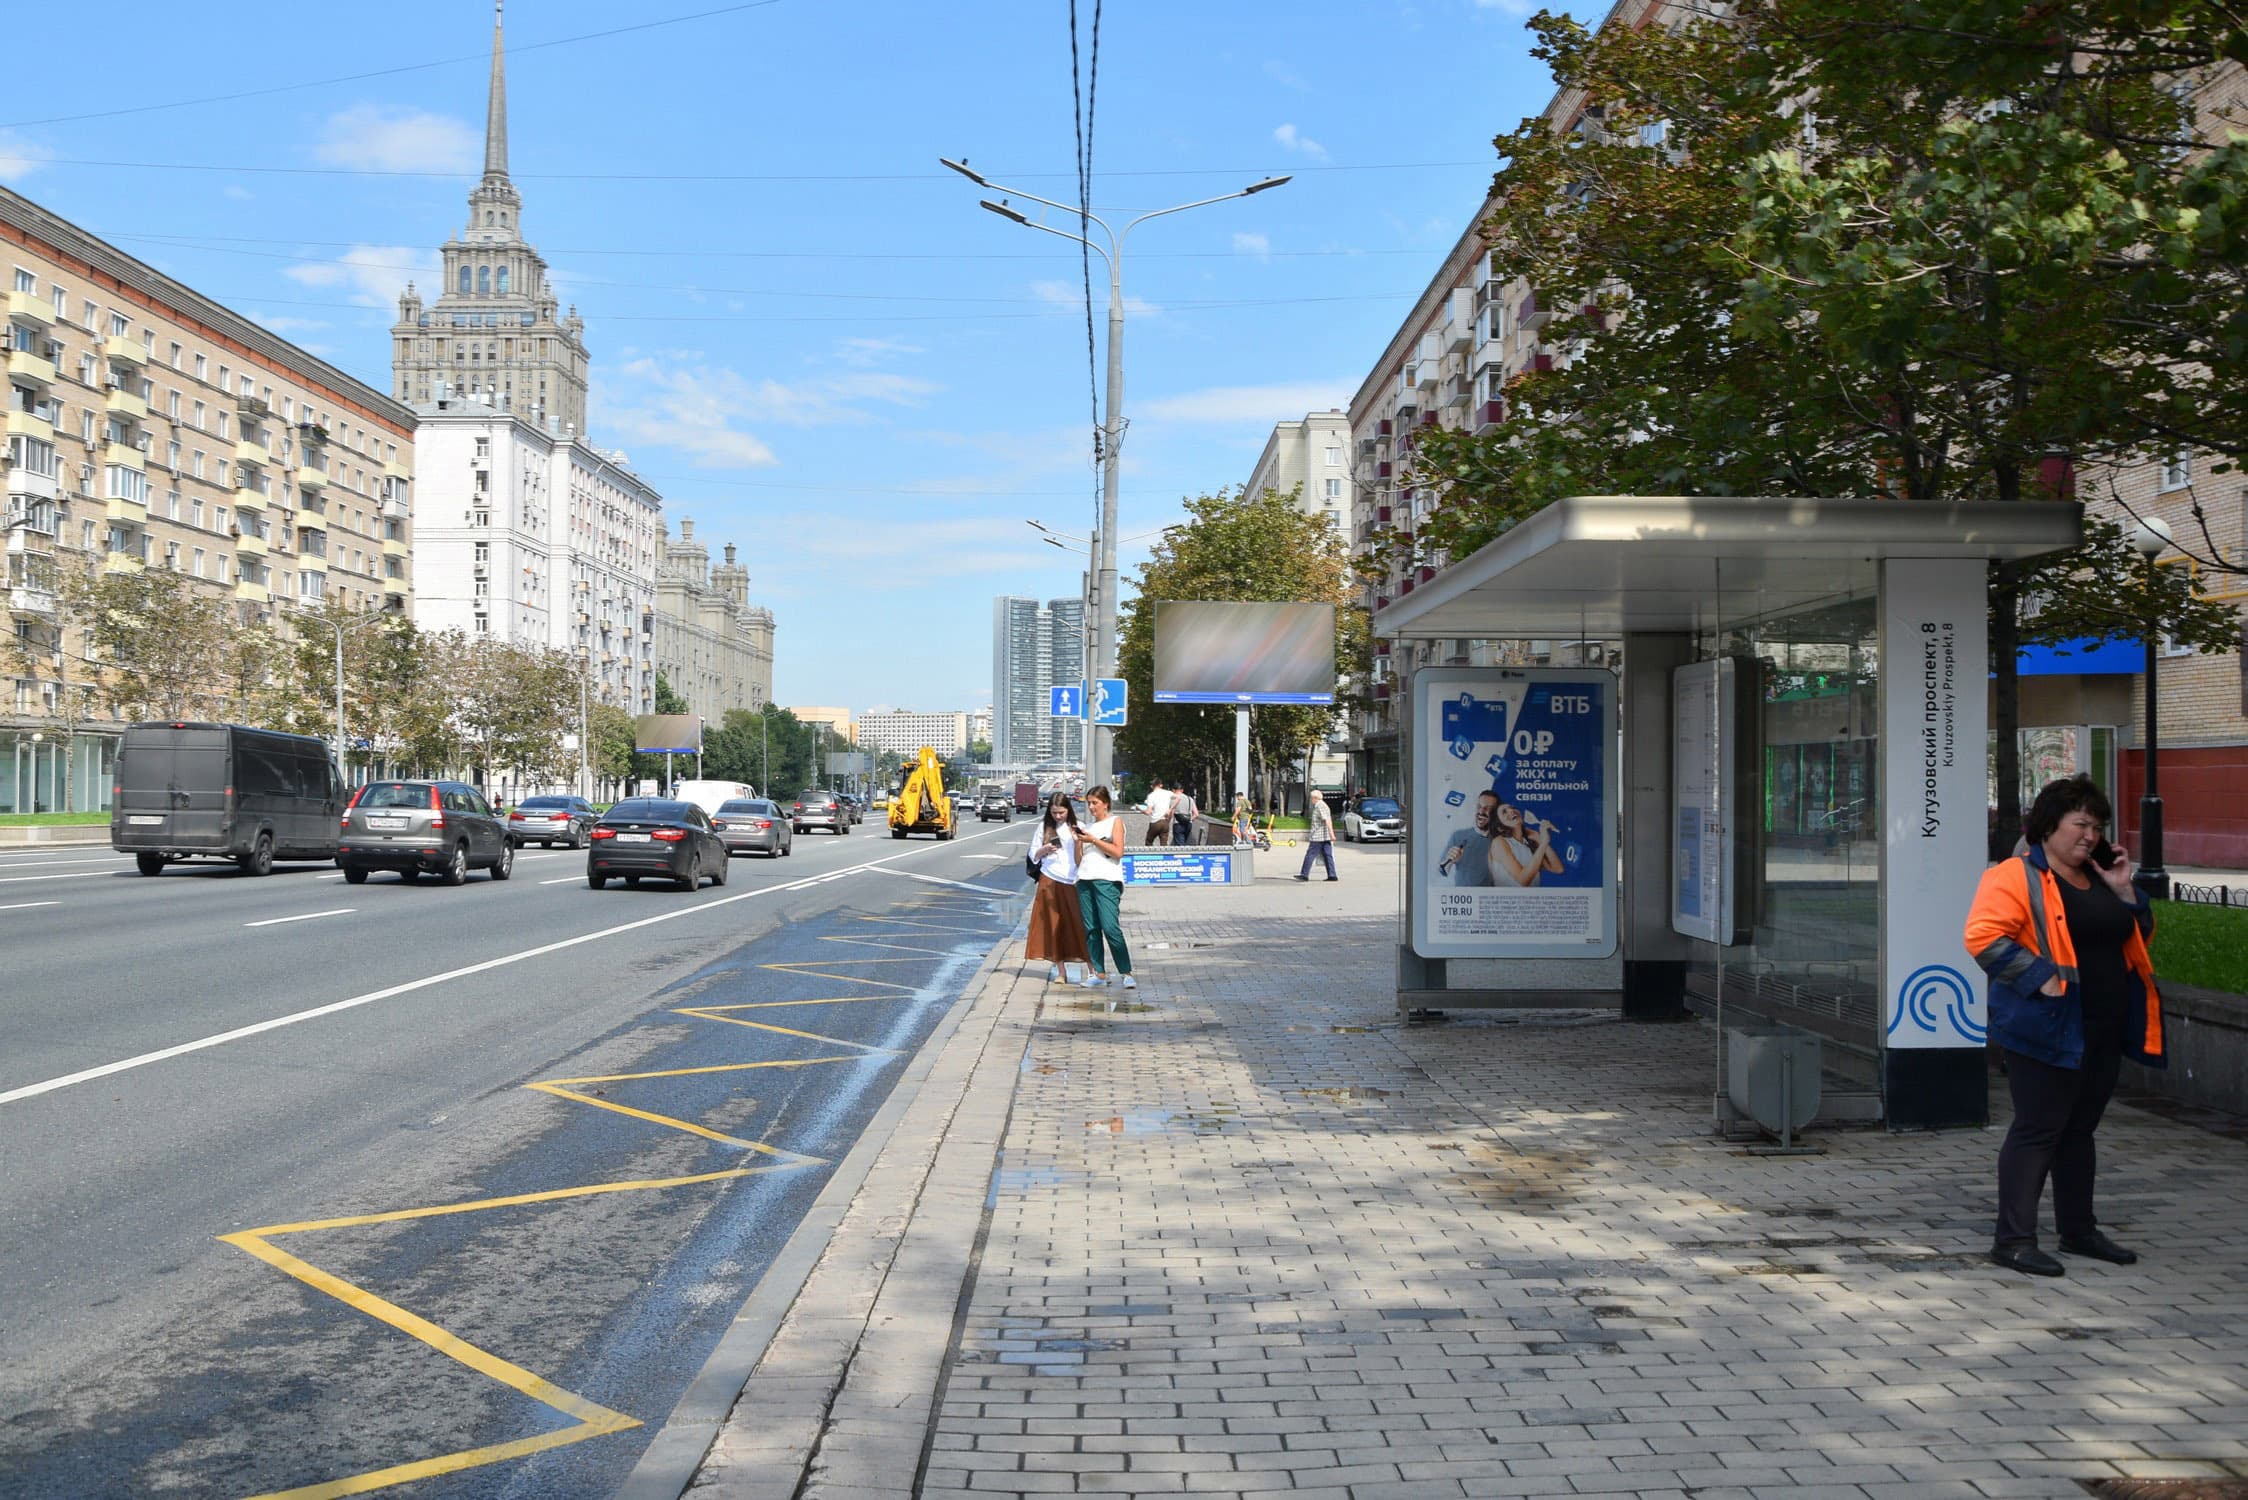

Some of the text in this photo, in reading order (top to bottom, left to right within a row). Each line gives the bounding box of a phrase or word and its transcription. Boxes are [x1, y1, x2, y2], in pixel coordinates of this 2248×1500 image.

[1942, 623, 1956, 767] Kutuzovskiy Prospekt, 8
[1551, 695, 1591, 714] ВТБ
[1921, 622, 1940, 838] Кутузовский проспект, 8
[1515, 759, 1577, 770] за оплату
[1515, 769, 1557, 779] ЖКХ и
[1515, 779, 1590, 790] мобильной
[1515, 792, 1552, 801] связи
[1133, 859, 1183, 867] МОСКОВСКИЙ
[1449, 895, 1473, 904] 1000
[1441, 907, 1473, 916] VTB.RU
